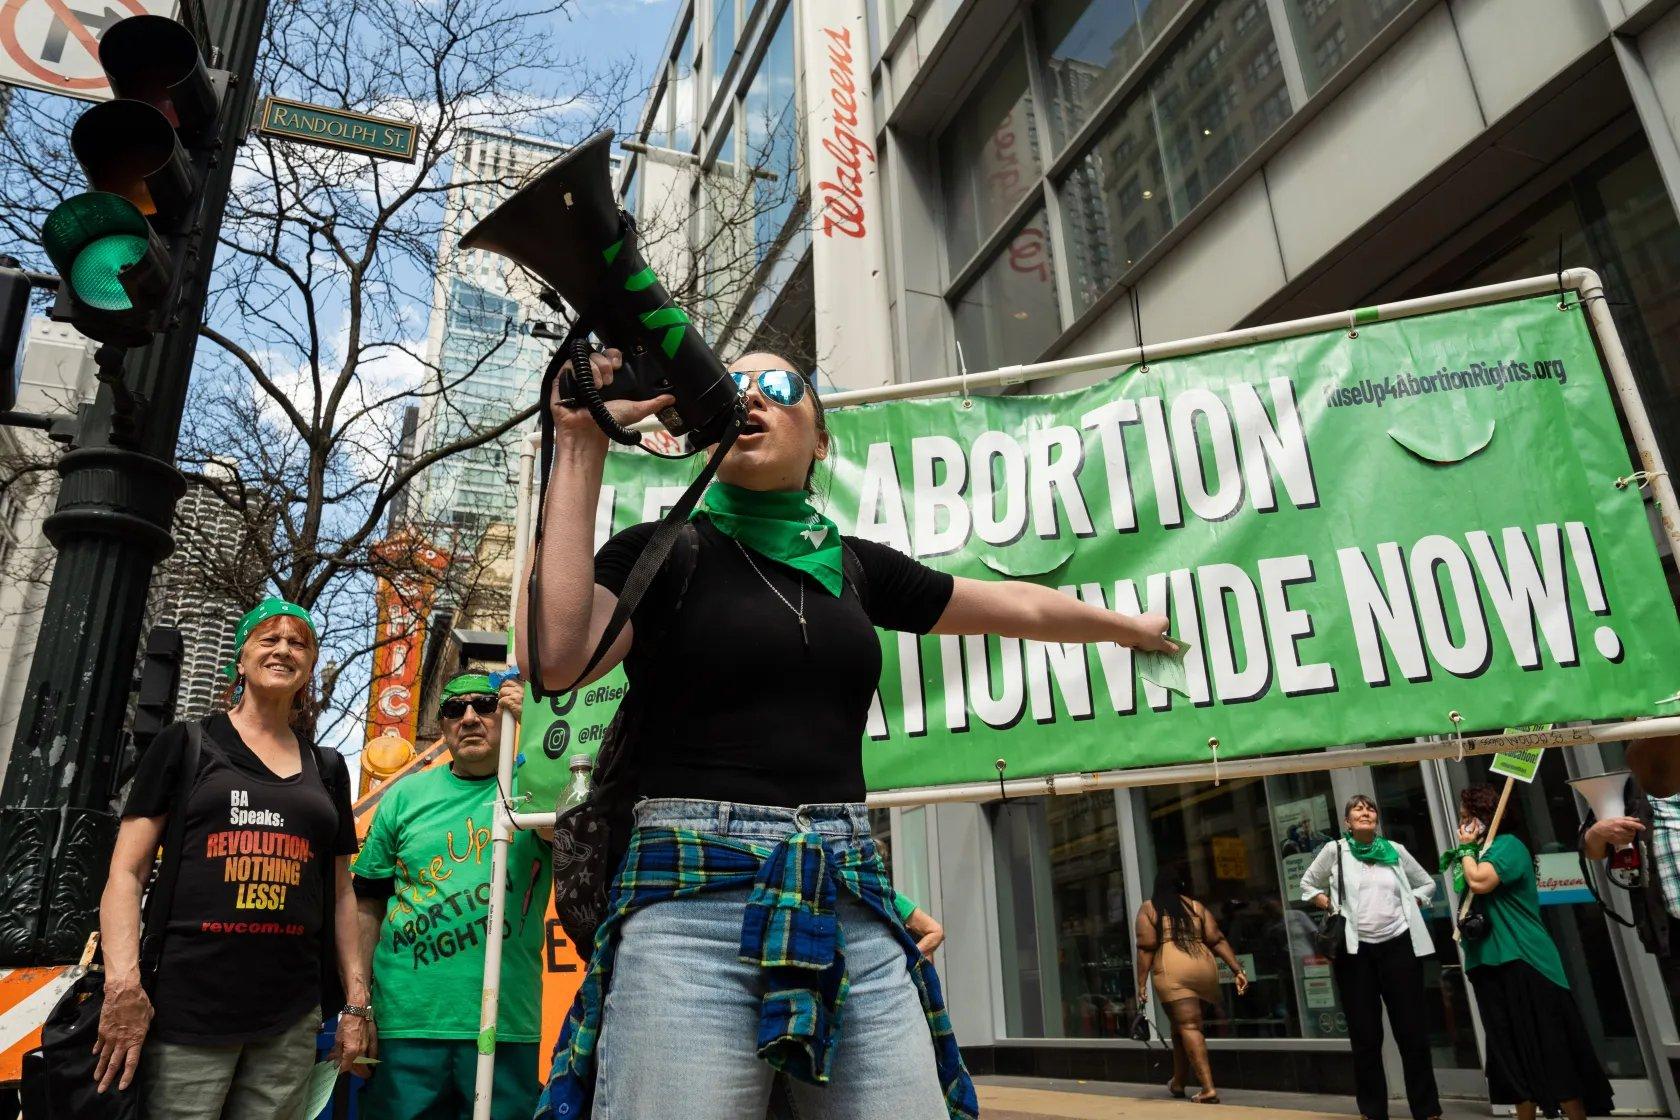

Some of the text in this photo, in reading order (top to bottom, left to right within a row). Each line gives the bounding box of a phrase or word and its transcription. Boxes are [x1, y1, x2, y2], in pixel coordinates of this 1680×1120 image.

[273, 107, 377, 143] RANDOLPH
[818, 26, 876, 239] Walgreens
[854, 376, 1319, 559] ABORTION
[1336, 521, 1624, 688] NOW!
[230, 790, 249, 807] BA
[230, 807, 285, 827] Speaks:
[224, 856, 301, 886] NOTHING
[235, 883, 287, 910] LESS!
[201, 922, 305, 936] revcom.us
